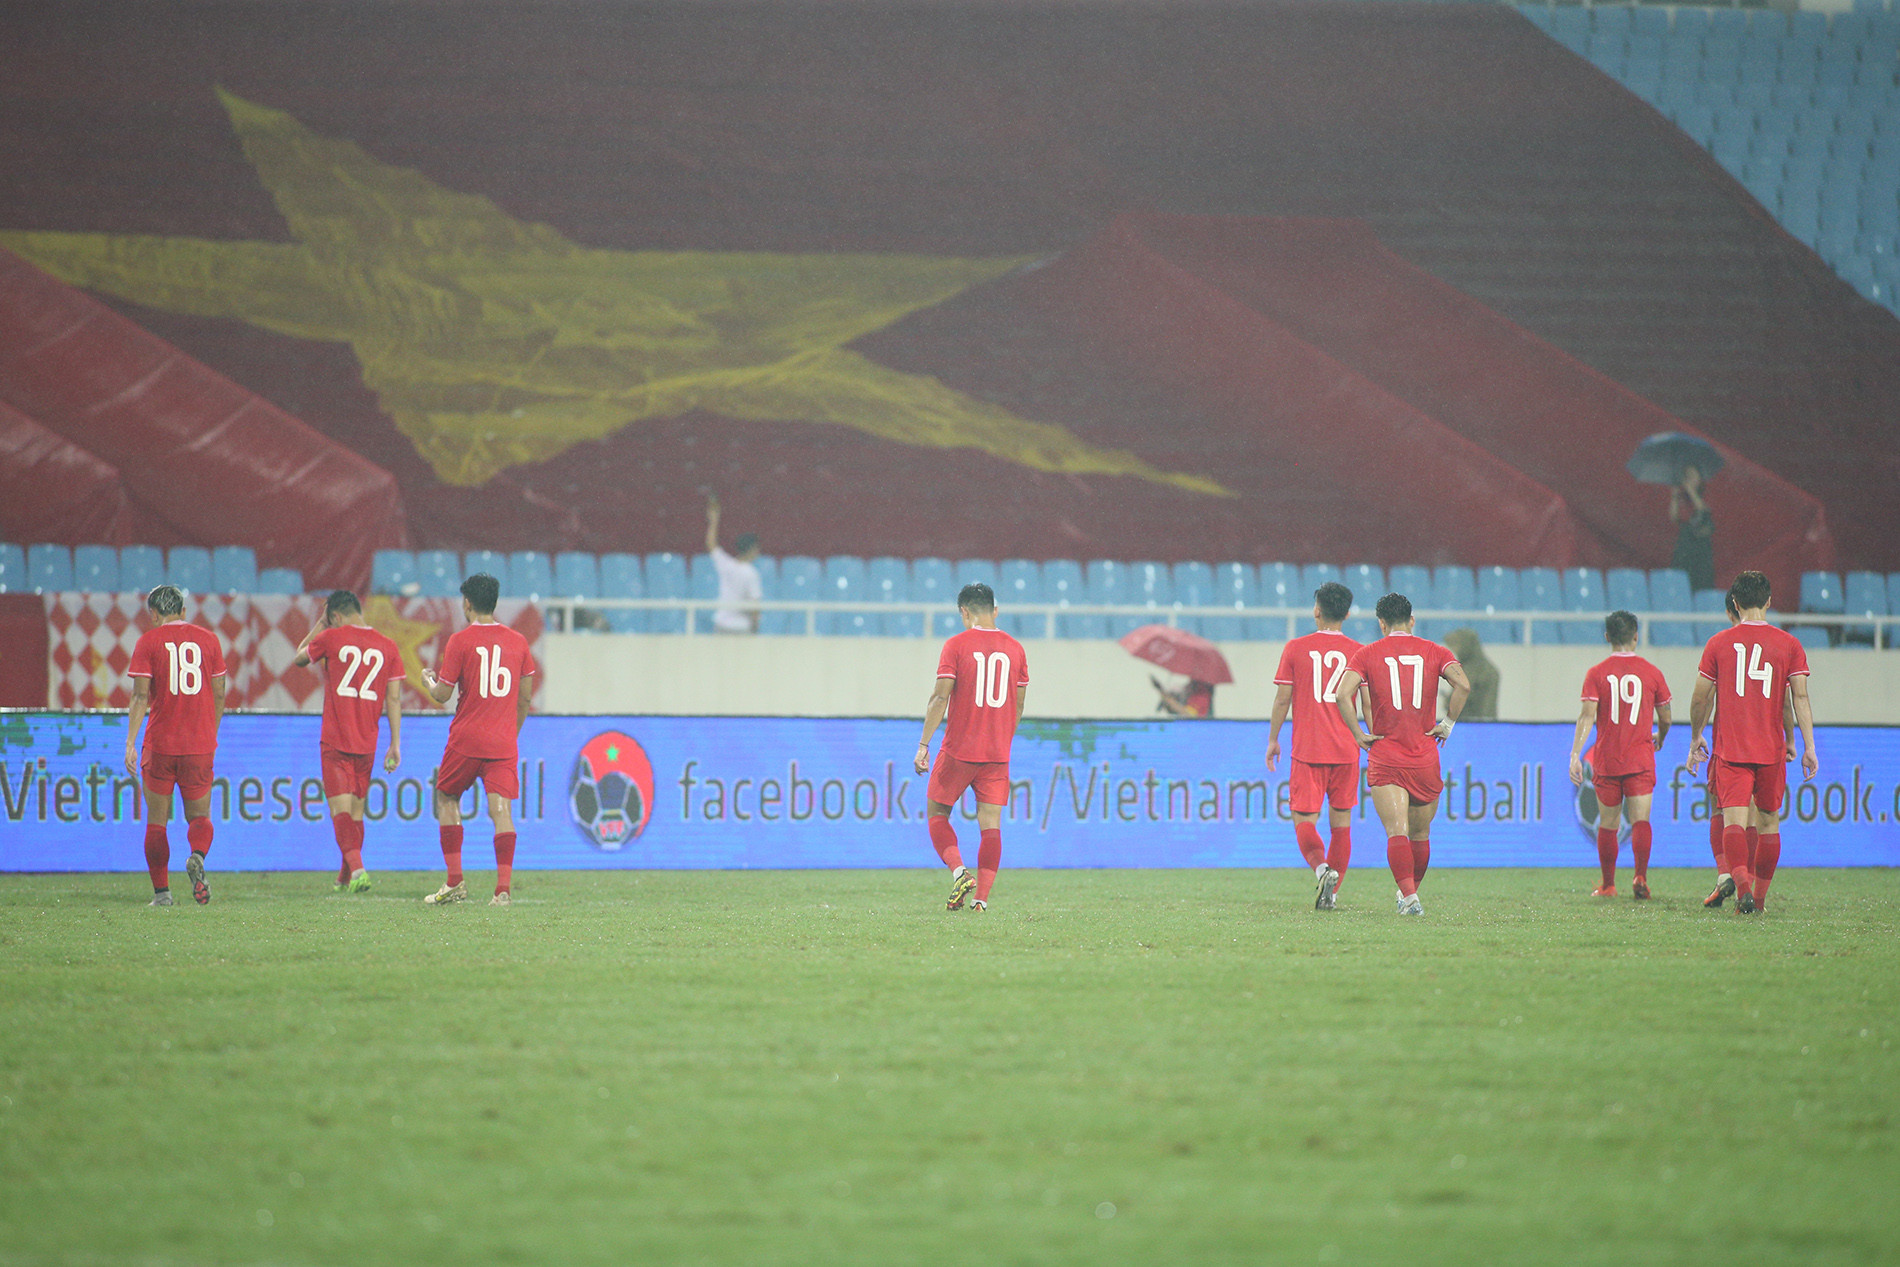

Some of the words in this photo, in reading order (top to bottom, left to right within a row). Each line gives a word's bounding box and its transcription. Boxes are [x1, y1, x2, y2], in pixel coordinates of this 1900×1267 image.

[165, 641, 203, 696] 18
[336, 645, 386, 701] 22
[475, 645, 512, 699] 16
[972, 651, 1011, 709] 10
[1308, 650, 1347, 703] 12
[1384, 654, 1425, 711] 17
[1733, 642, 1774, 699] 14
[1606, 673, 1643, 726] 19
[1669, 765, 1900, 822] faook.
